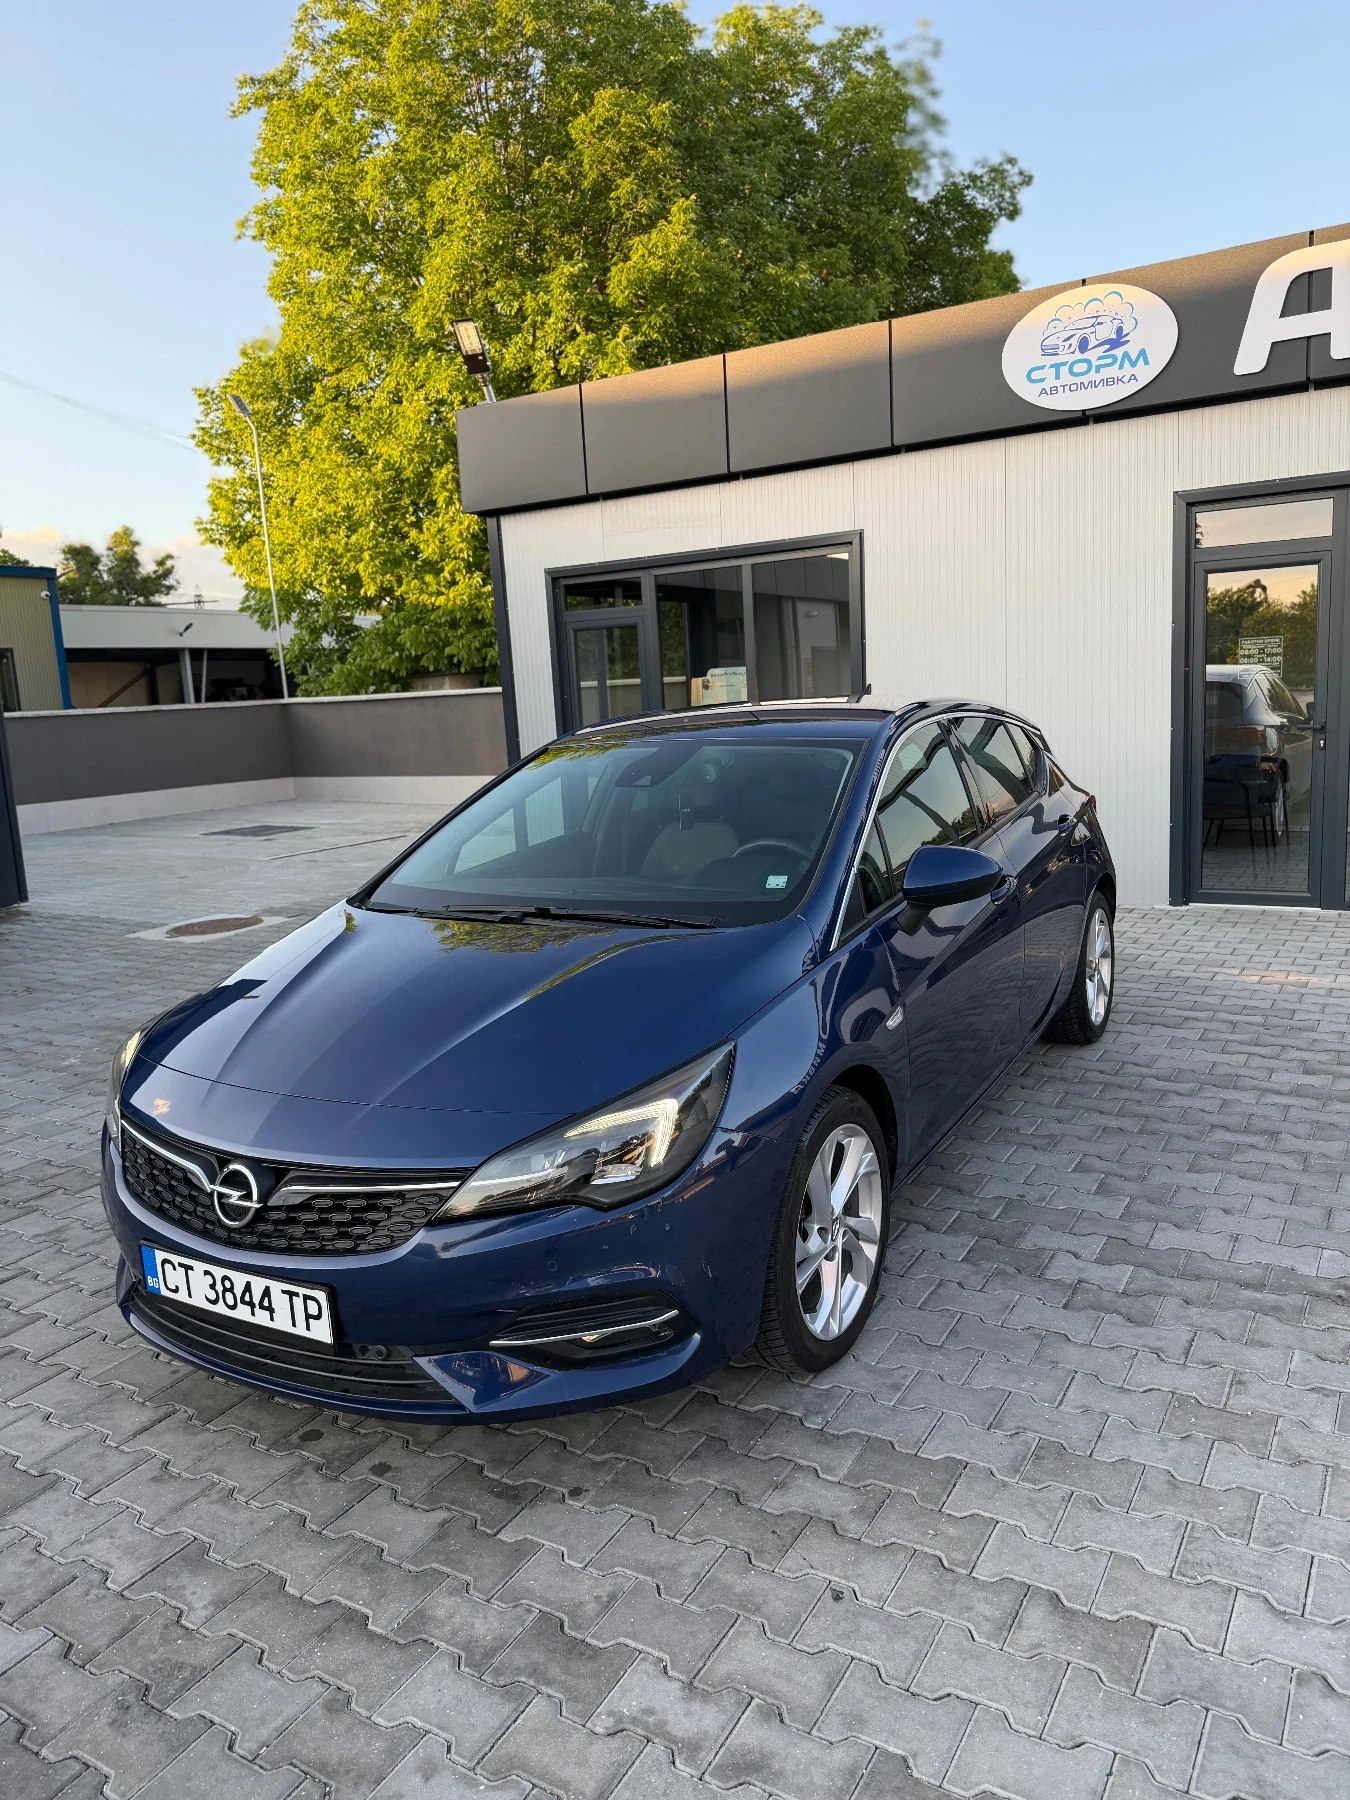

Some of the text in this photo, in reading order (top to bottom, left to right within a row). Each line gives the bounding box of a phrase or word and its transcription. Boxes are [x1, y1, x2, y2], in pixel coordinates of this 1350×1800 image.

[1025, 347, 1150, 384] СТОРМ
[1037, 373, 1138, 398] АВТОМИВКА
[147, 1275, 160, 1289] BG
[160, 1257, 323, 1332] CT 3844 TP
